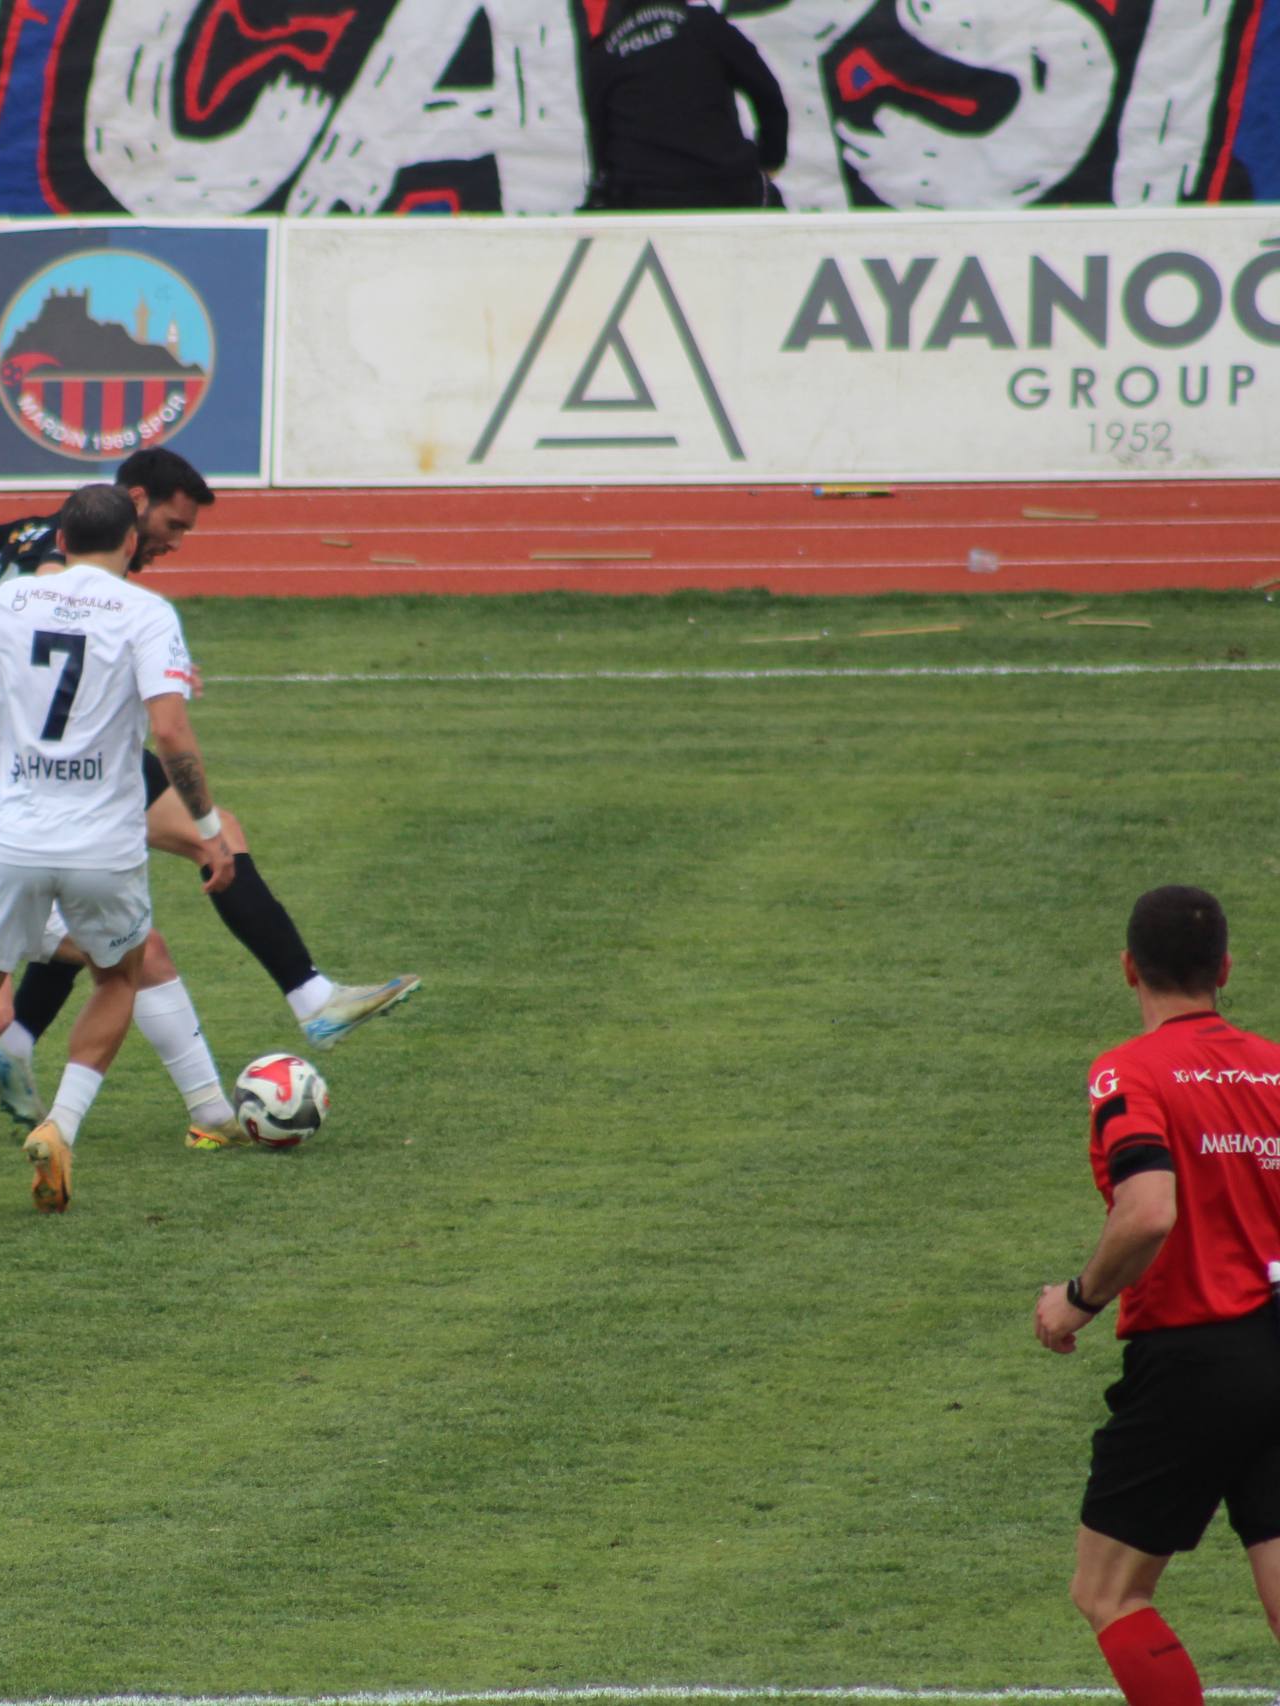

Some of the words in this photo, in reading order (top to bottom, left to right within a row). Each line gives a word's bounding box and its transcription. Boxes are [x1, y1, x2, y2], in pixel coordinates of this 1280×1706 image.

[1007, 364, 1256, 410] GROUP
[18, 393, 87, 449] MARDIN
[138, 395, 186, 439] SPOR
[1086, 422, 1173, 454] 1952
[30, 630, 87, 741] 7
